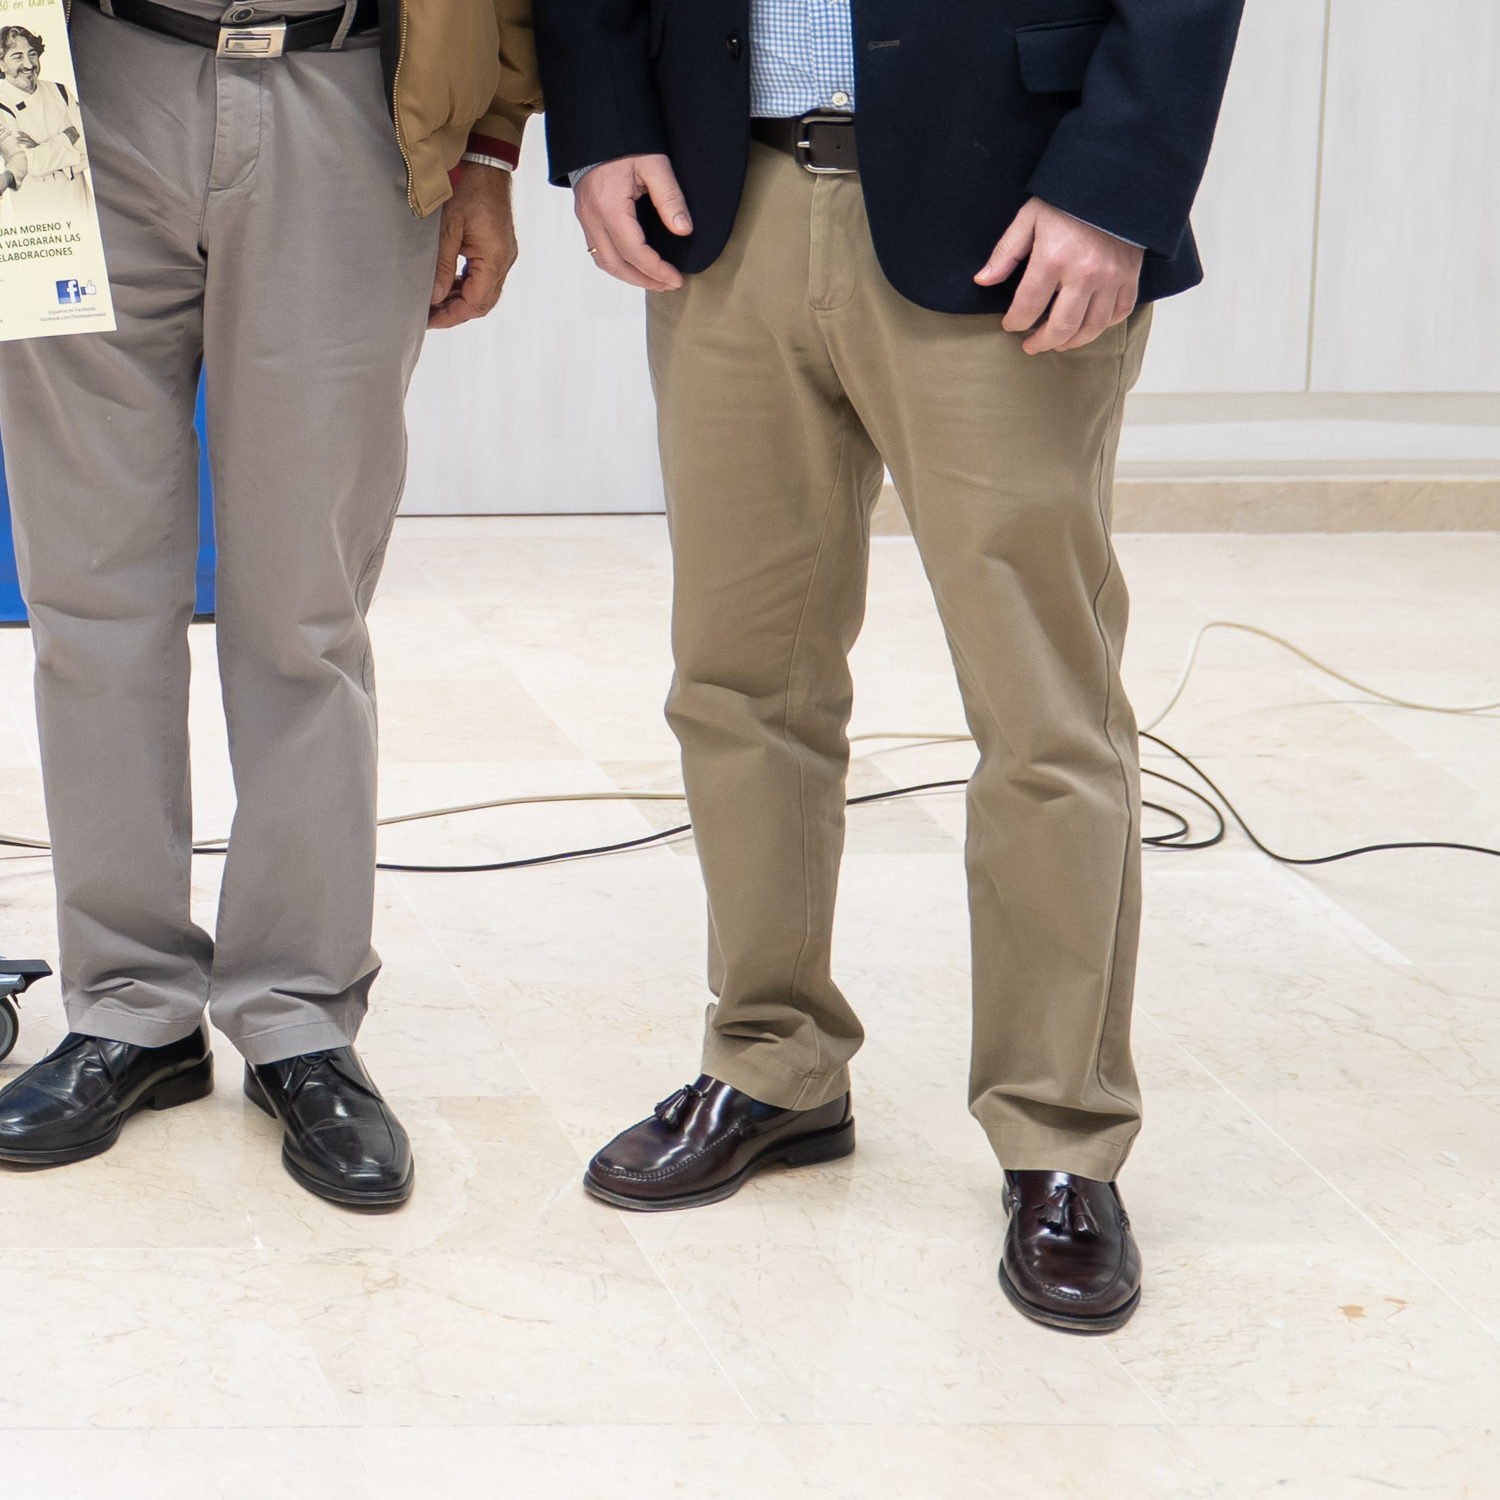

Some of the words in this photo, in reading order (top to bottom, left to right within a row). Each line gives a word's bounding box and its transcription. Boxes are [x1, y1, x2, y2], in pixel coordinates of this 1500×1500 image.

[13, 1, 24, 9] en
[20, 222, 62, 234] MORENO
[66, 221, 72, 230] Y
[5, 234, 62, 249] VALORARÁN
[64, 233, 81, 243] LAS
